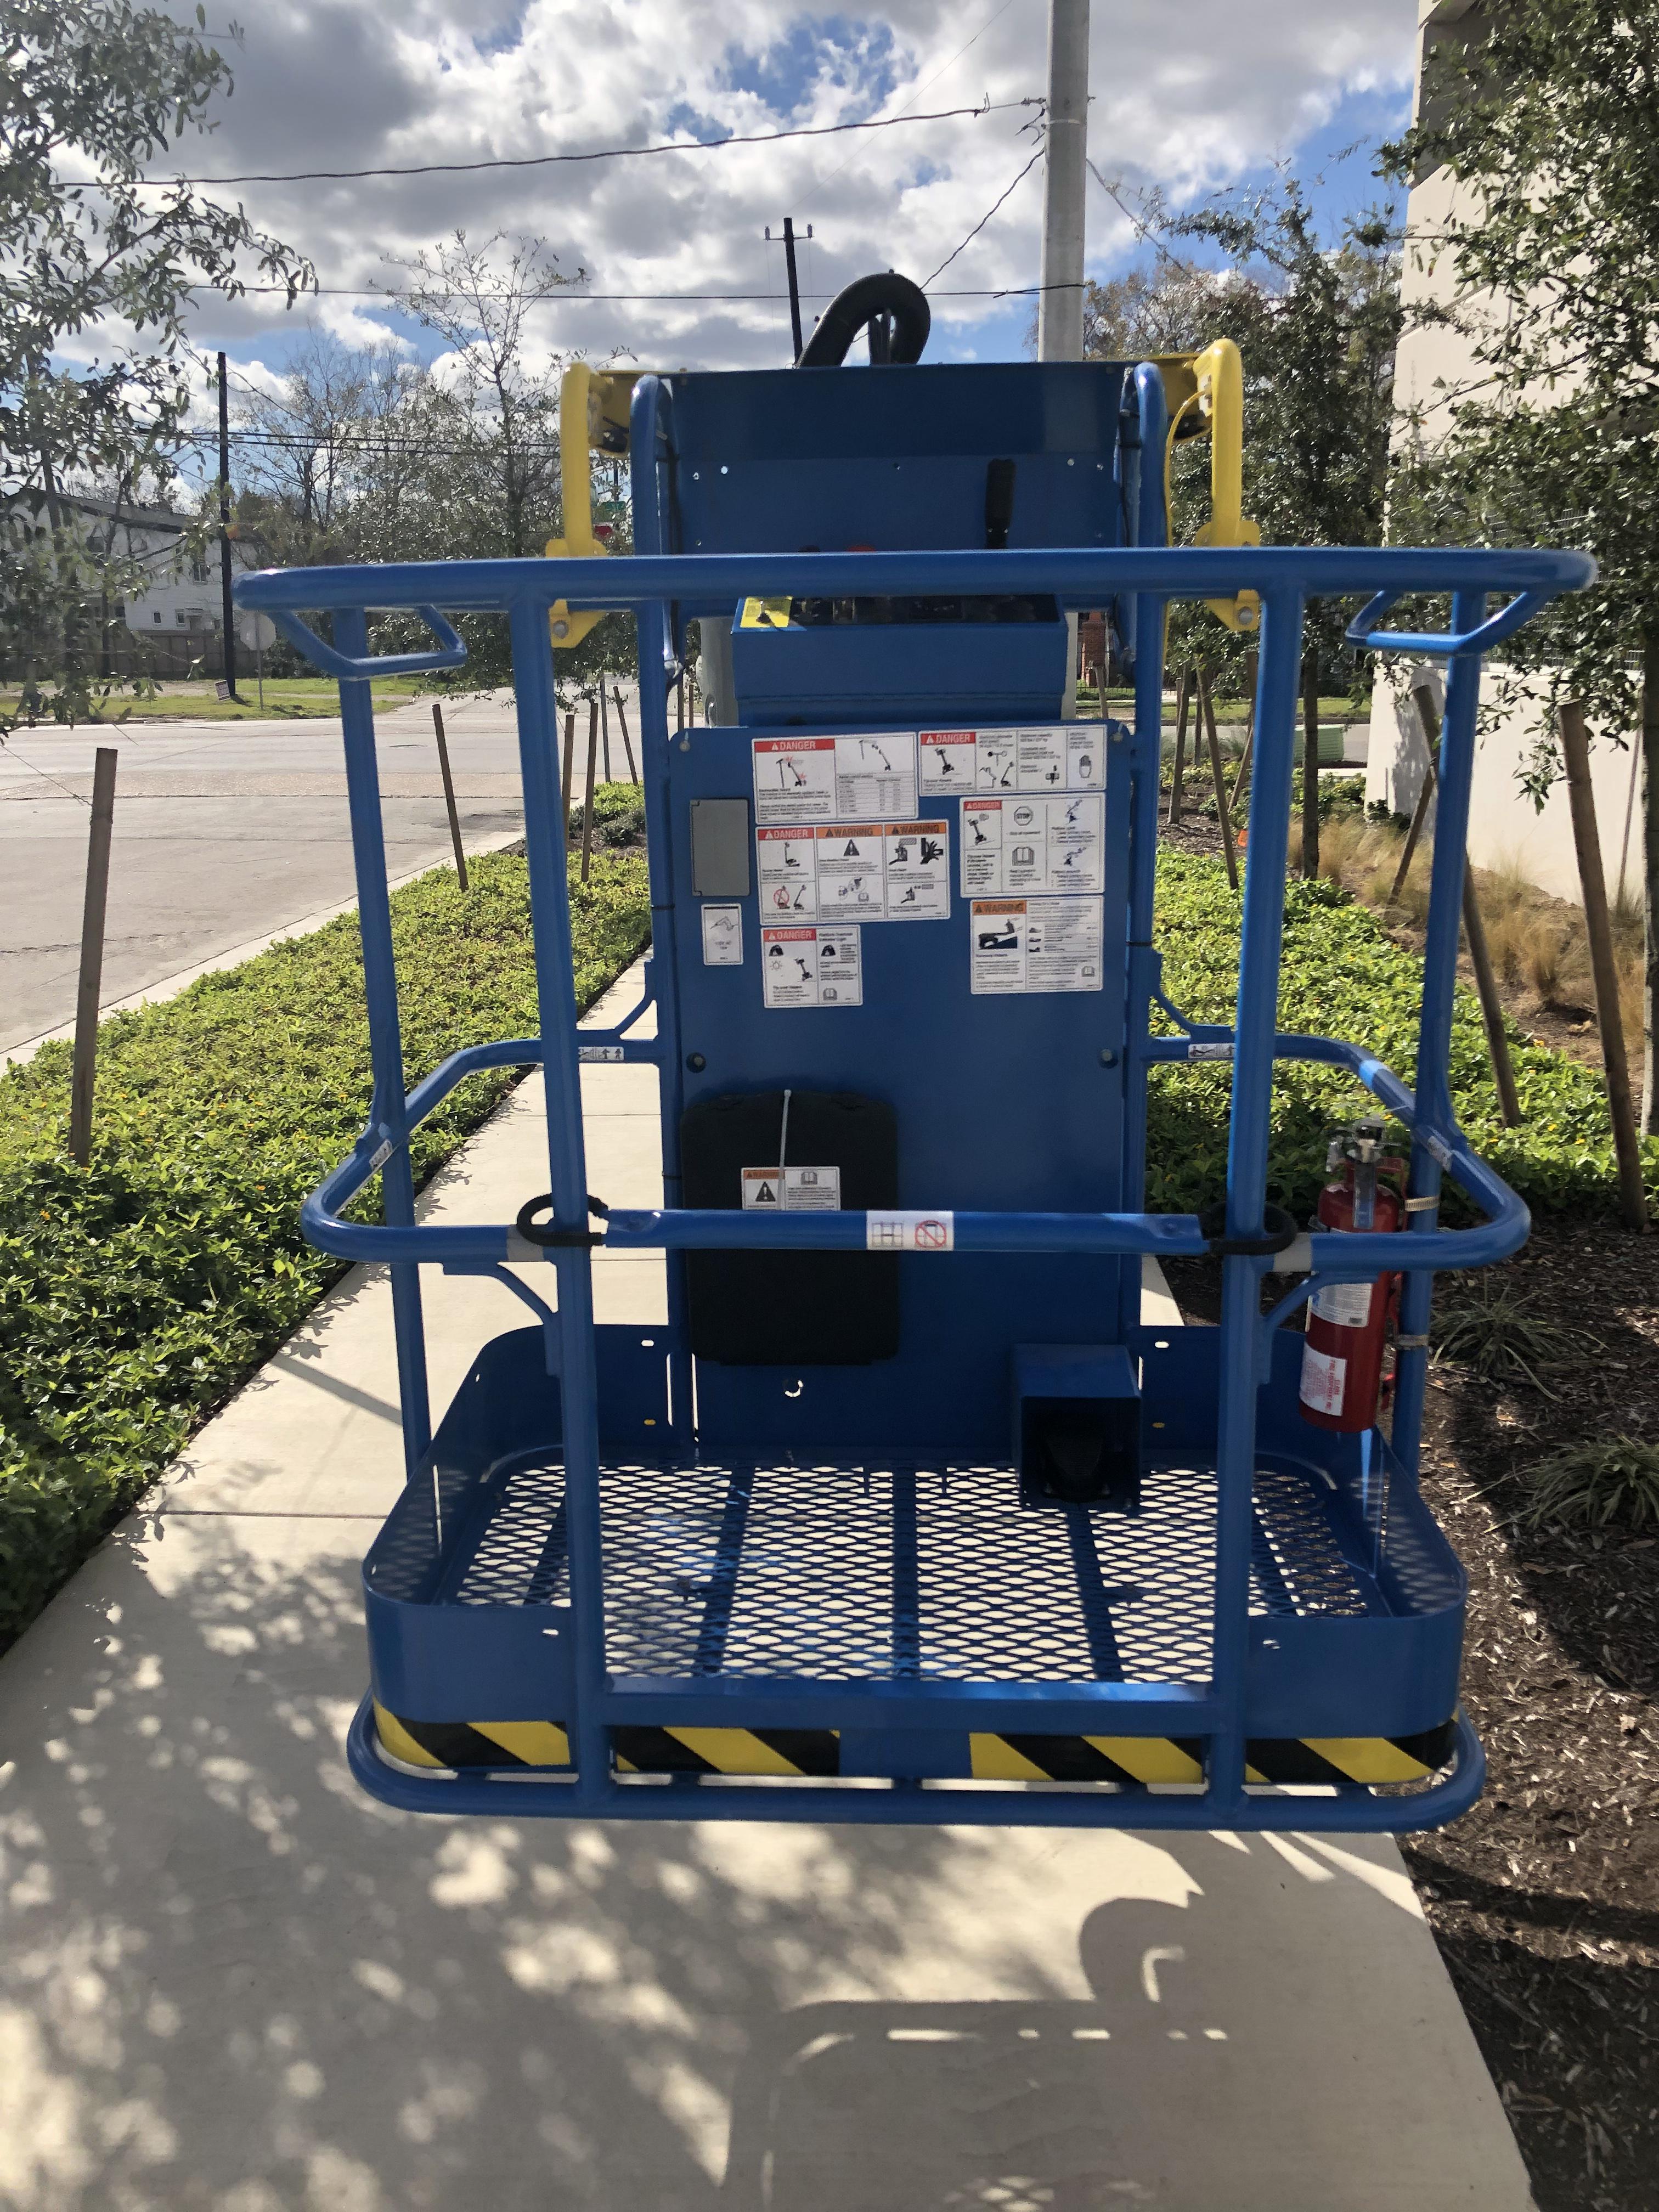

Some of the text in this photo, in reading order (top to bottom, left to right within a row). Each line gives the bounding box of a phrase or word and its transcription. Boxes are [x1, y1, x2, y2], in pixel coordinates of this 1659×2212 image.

[936, 734, 970, 743] DANGER
[780, 741, 816, 751] DANGER
[973, 802, 1000, 810] DANGER
[772, 829, 808, 839] DANGER
[834, 827, 873, 837] WARNING
[900, 825, 939, 834] WARNING
[985, 903, 1023, 912] WARNING
[777, 930, 812, 940] DANGER
